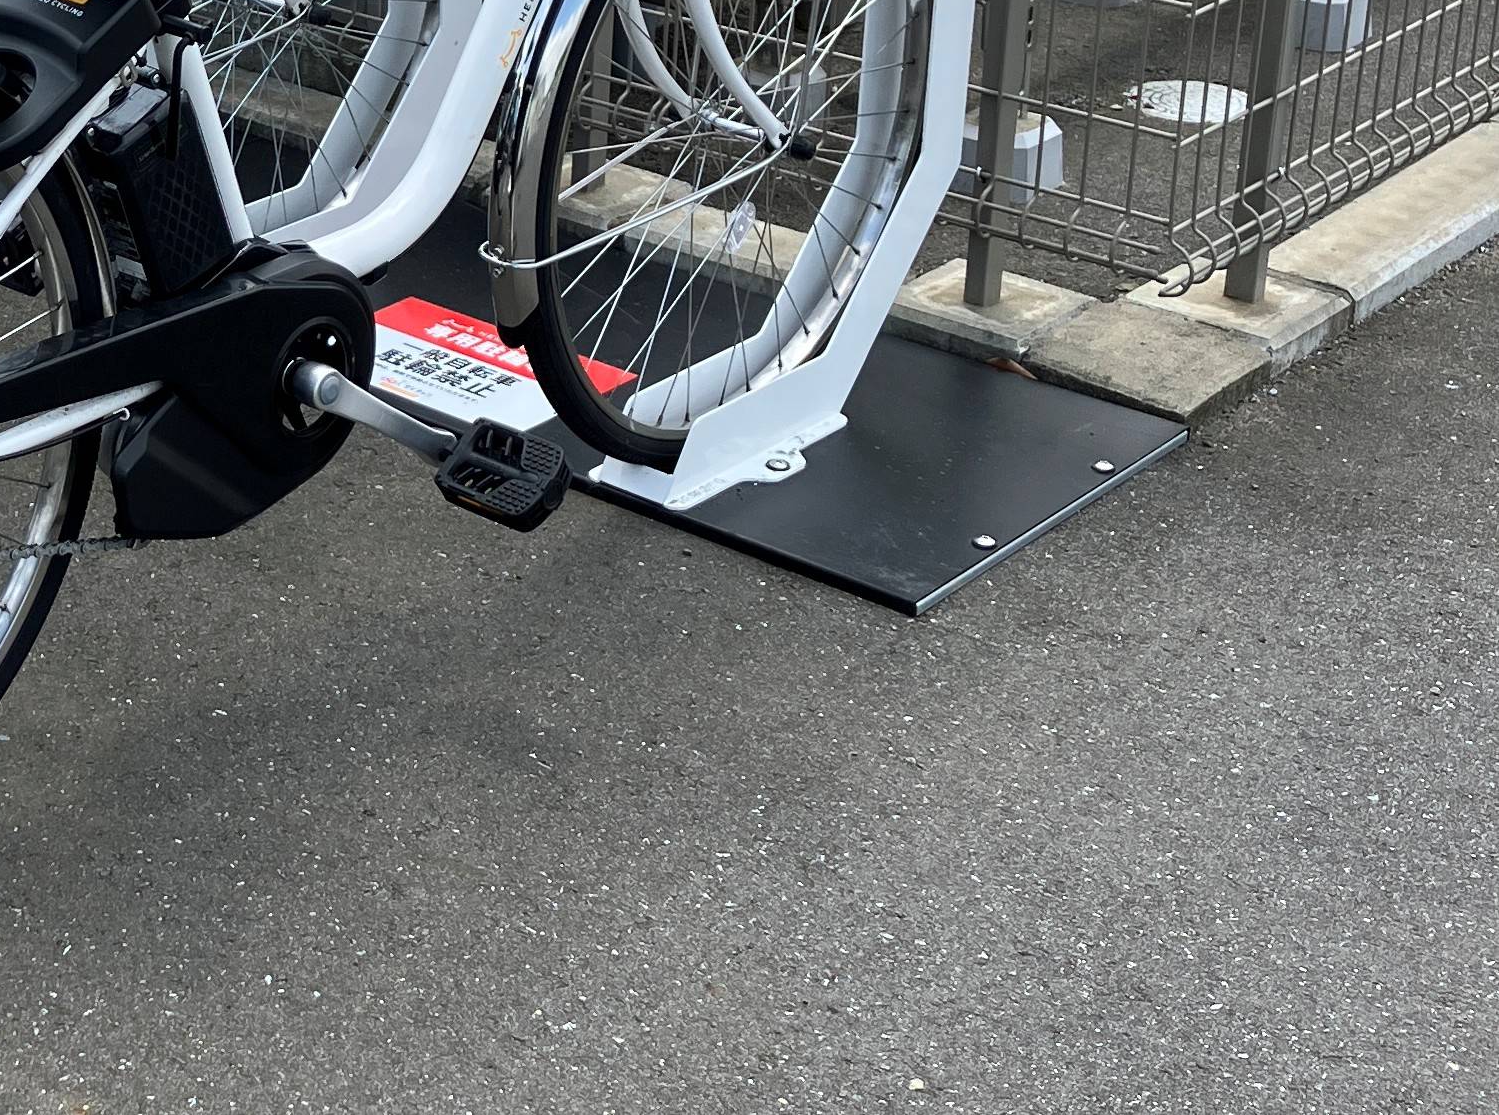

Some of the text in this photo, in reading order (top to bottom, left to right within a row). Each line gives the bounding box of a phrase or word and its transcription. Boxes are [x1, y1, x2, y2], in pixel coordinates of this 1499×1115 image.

[375, 348, 496, 399] 駐輪禁止
[403, 341, 522, 387] 一般自転車
